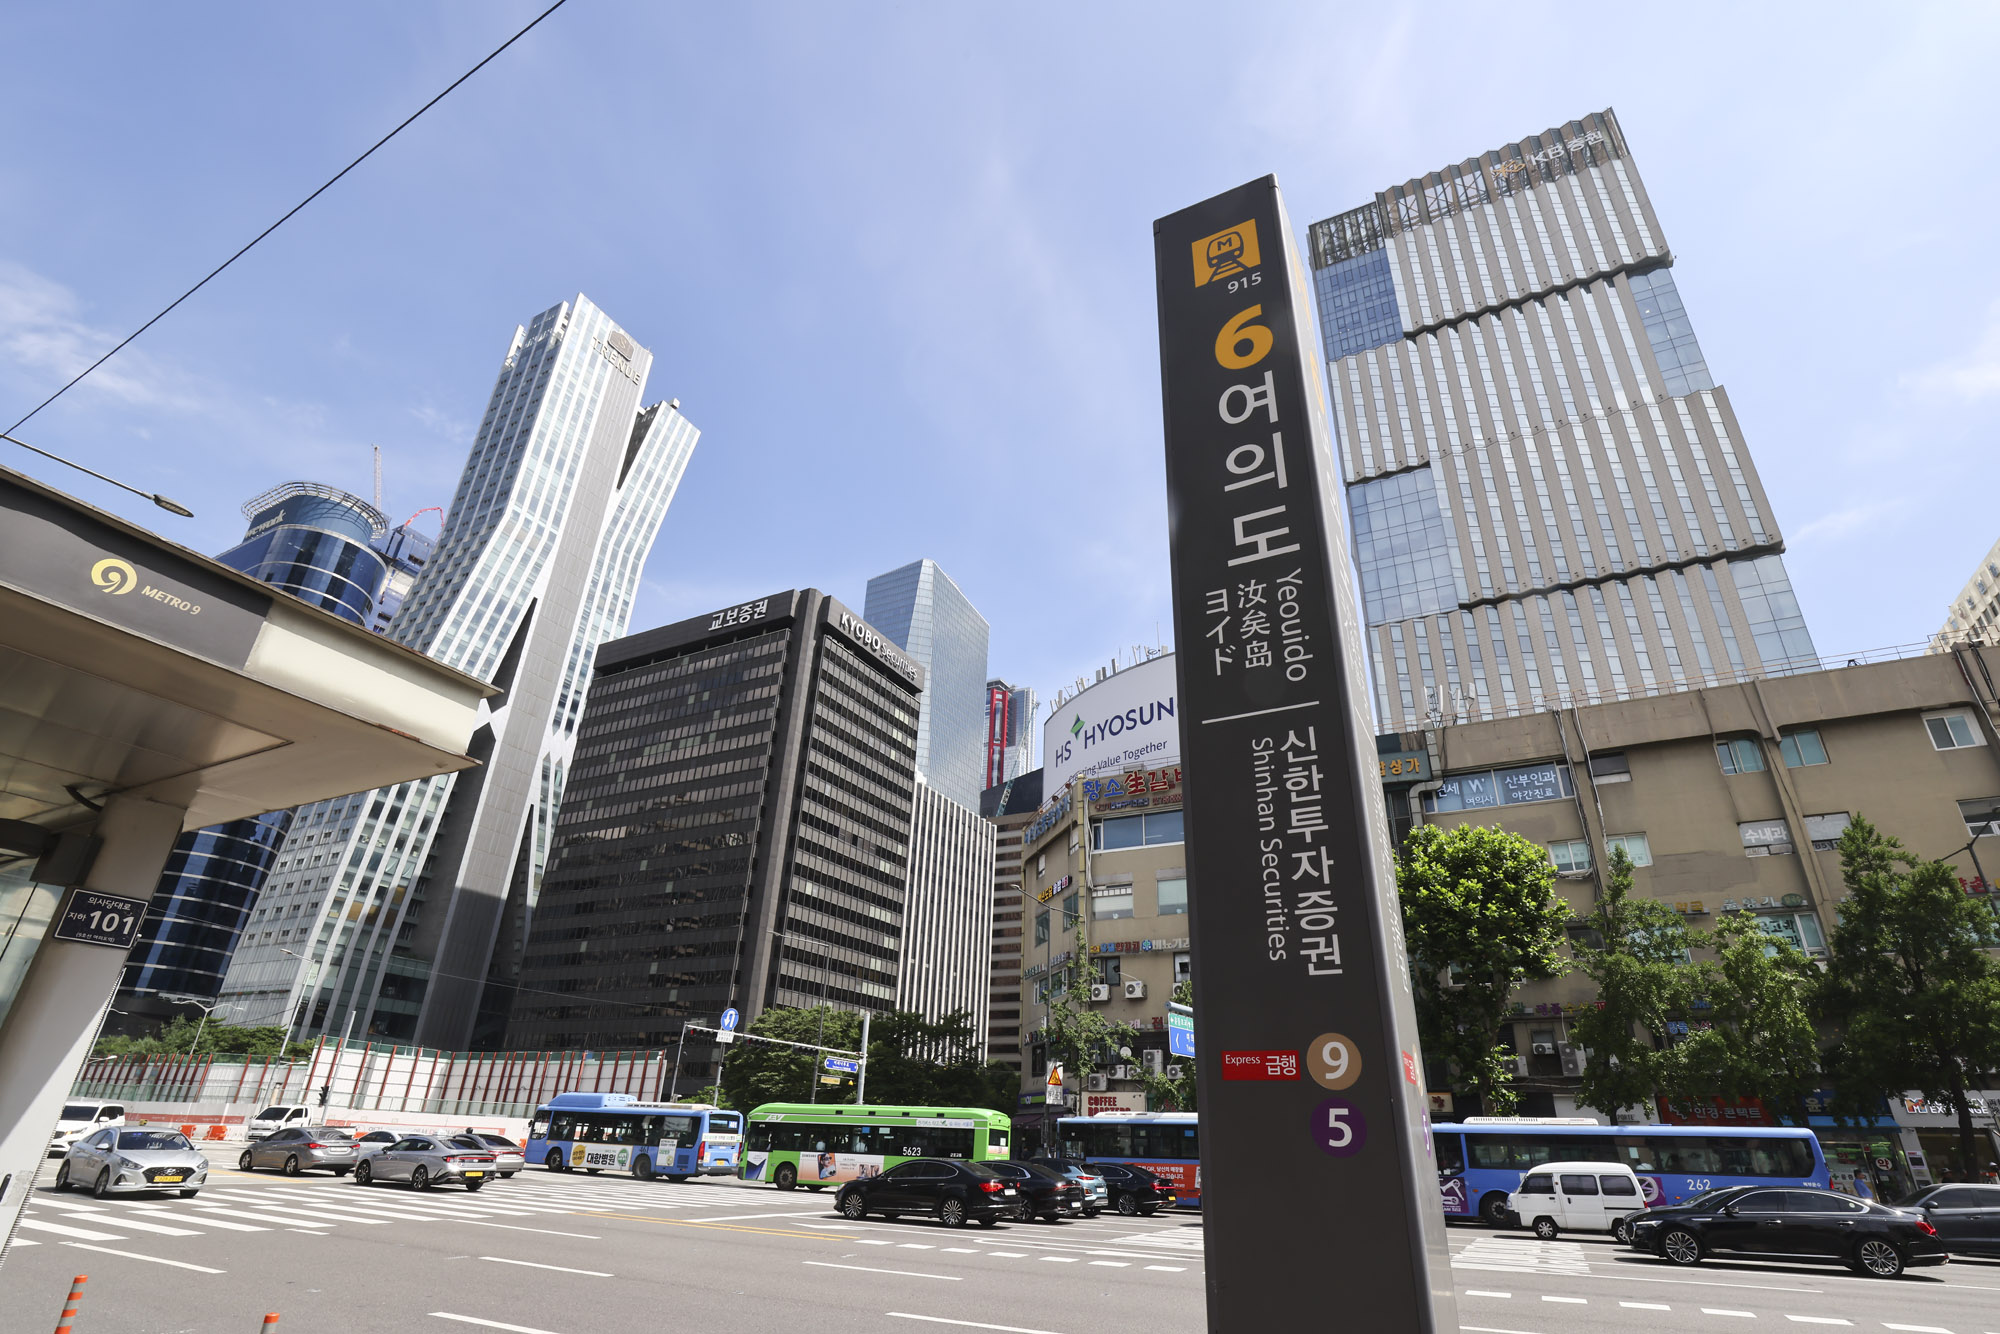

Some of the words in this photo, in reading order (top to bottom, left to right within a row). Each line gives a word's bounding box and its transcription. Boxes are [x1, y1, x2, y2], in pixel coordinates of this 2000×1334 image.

[1227, 271, 1262, 294] 915
[1214, 303, 1274, 370] 6
[1218, 369, 1302, 568] 여의도
[141, 585, 191, 612] METRO
[190, 605, 202, 616] 9
[708, 600, 769, 631] 교보증권
[1205, 588, 1237, 676] ヨイド
[1237, 579, 1273, 669] 汝矣岛
[1276, 567, 1314, 682] Yeouido
[841, 611, 881, 650] KYOBO
[880, 642, 918, 680] Securities
[1055, 740, 1072, 768] HS
[1097, 754, 1121, 770] Value
[1122, 740, 1168, 761] Together
[1083, 778, 1125, 801] 황소
[1252, 737, 1279, 832] Shinhan
[1504, 770, 1556, 790] 산부인과
[1512, 788, 1555, 801] 야간진료
[1465, 794, 1494, 806] 여의사
[1280, 726, 1343, 976] 신한투자증권
[88, 896, 132, 911] 의사당대로
[1260, 838, 1290, 961] Securities
[68, 911, 87, 922] 지하
[90, 910, 135, 935] 101
[1225, 1054, 1261, 1067] Express
[1265, 1054, 1297, 1076] 급행
[1321, 1041, 1349, 1080] 9
[1088, 1096, 1117, 1107] COFFEE
[1328, 1107, 1353, 1148] 5
[586, 1152, 616, 1166] 대항병원
[902, 1146, 922, 1157] 5623
[1687, 1179, 1711, 1191] 262
